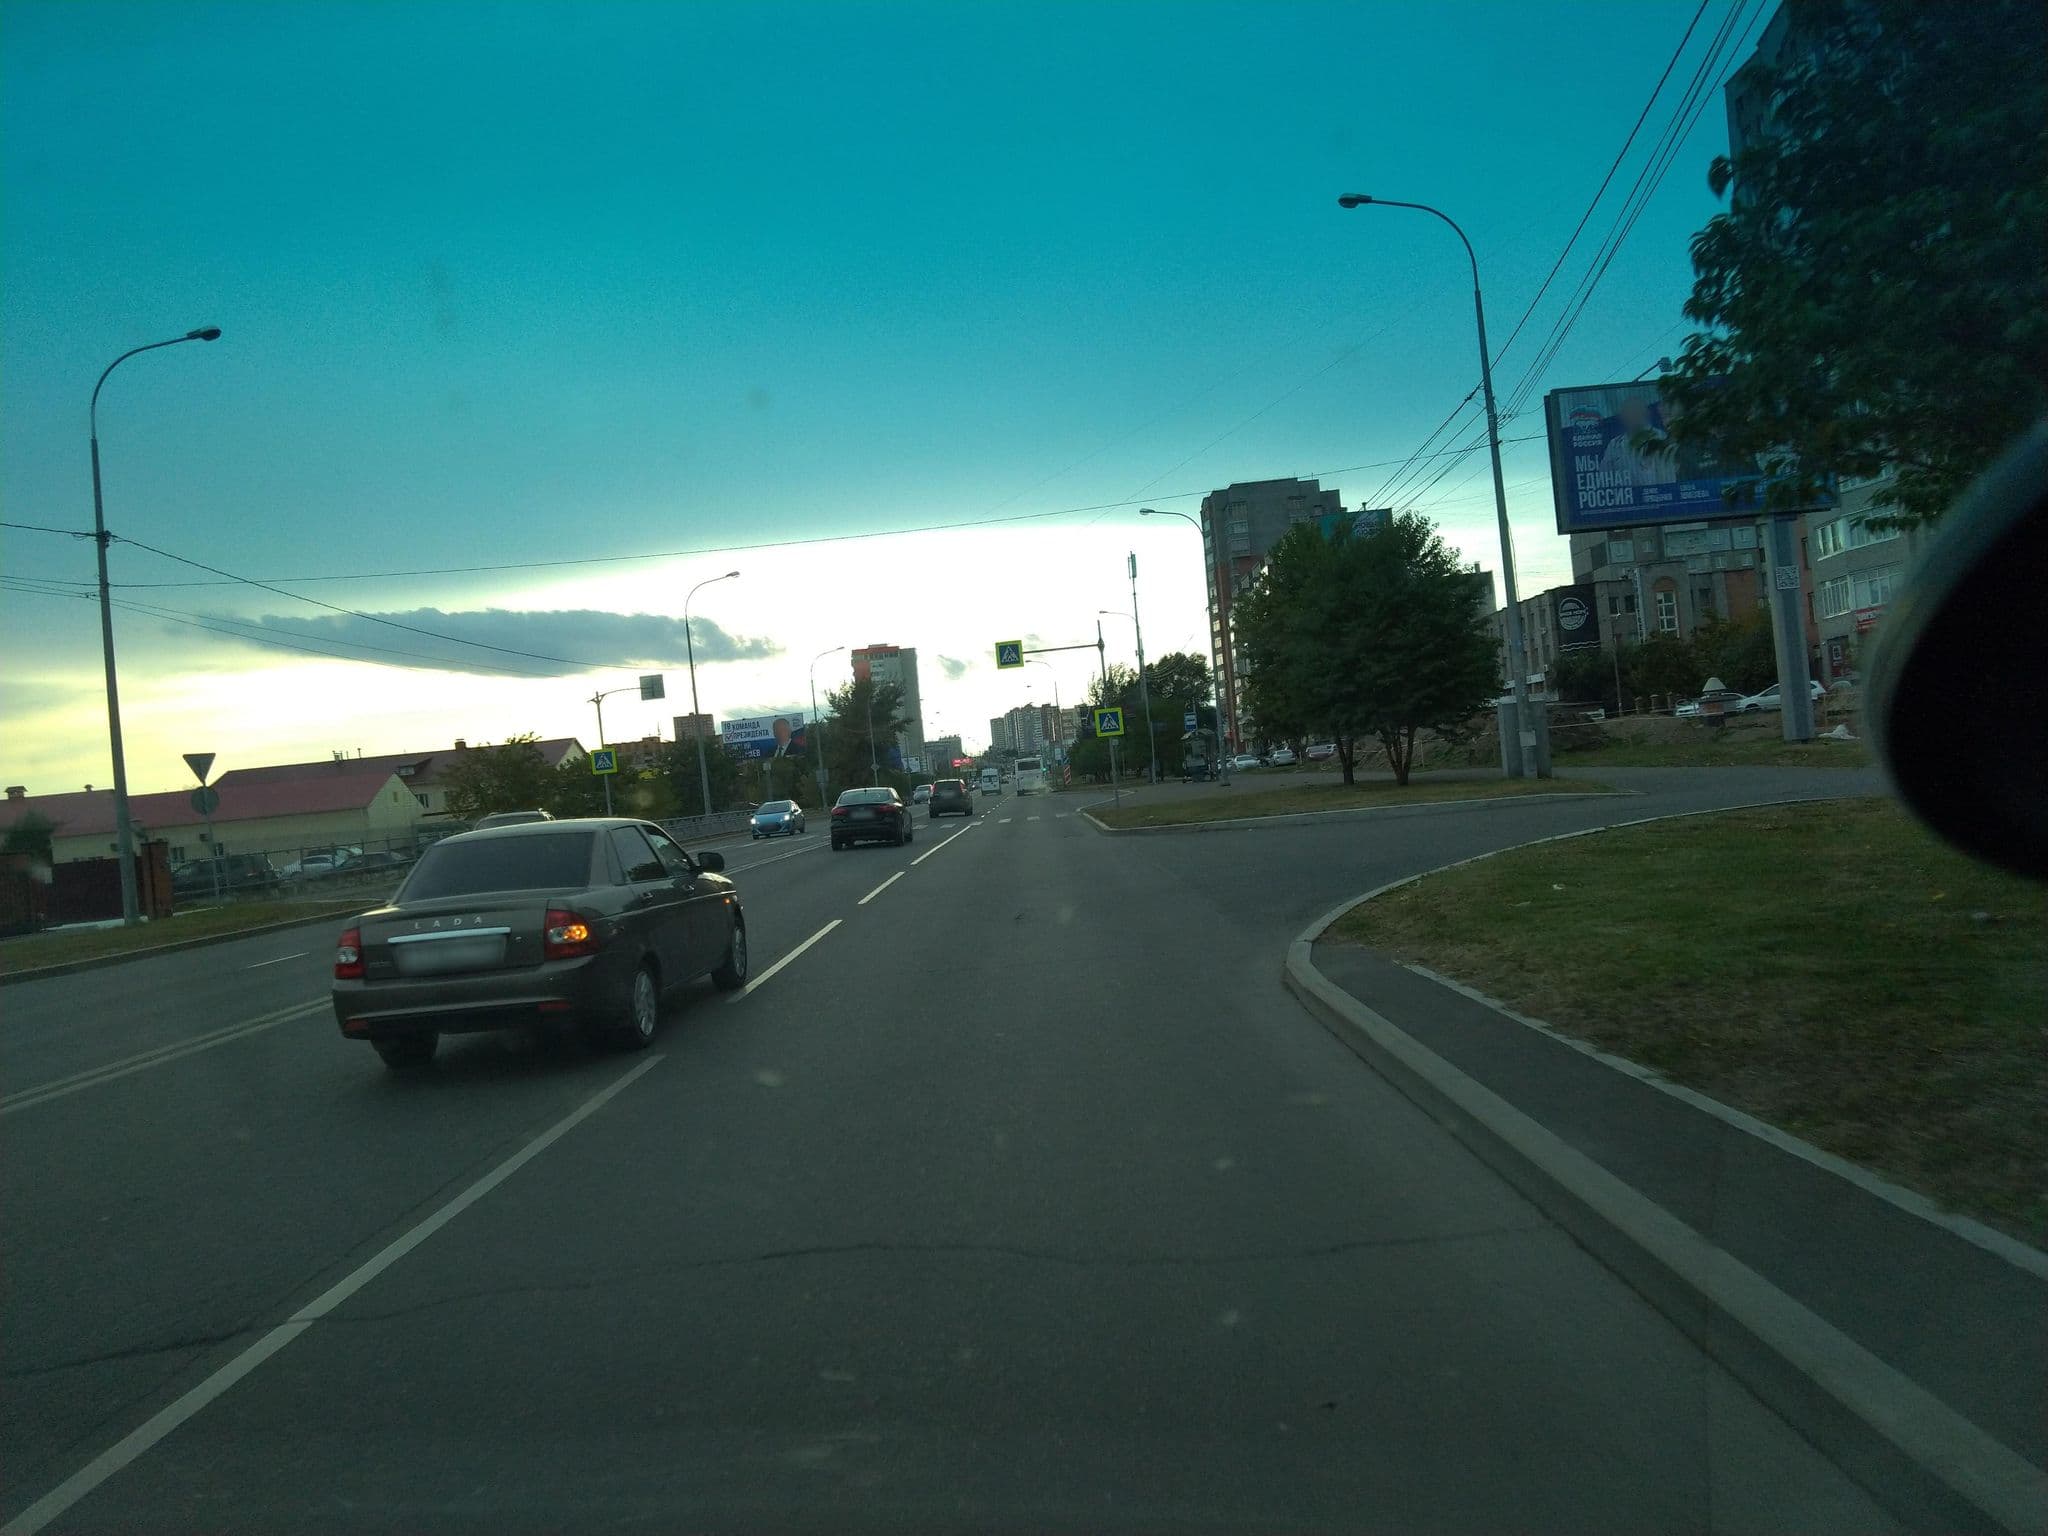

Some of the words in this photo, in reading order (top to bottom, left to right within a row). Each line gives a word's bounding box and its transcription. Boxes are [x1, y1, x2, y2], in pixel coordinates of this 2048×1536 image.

[1573, 440, 1603, 448] РОССИЯ
[1575, 454, 1600, 472] МЫ
[1577, 470, 1632, 491] ЕДИНАЯ
[1579, 487, 1634, 509] РОССИЯ
[732, 720, 761, 731] КОМАНДА
[733, 729, 770, 739] ПРЕЗИДЕНТА
[415, 916, 483, 930] LADA
